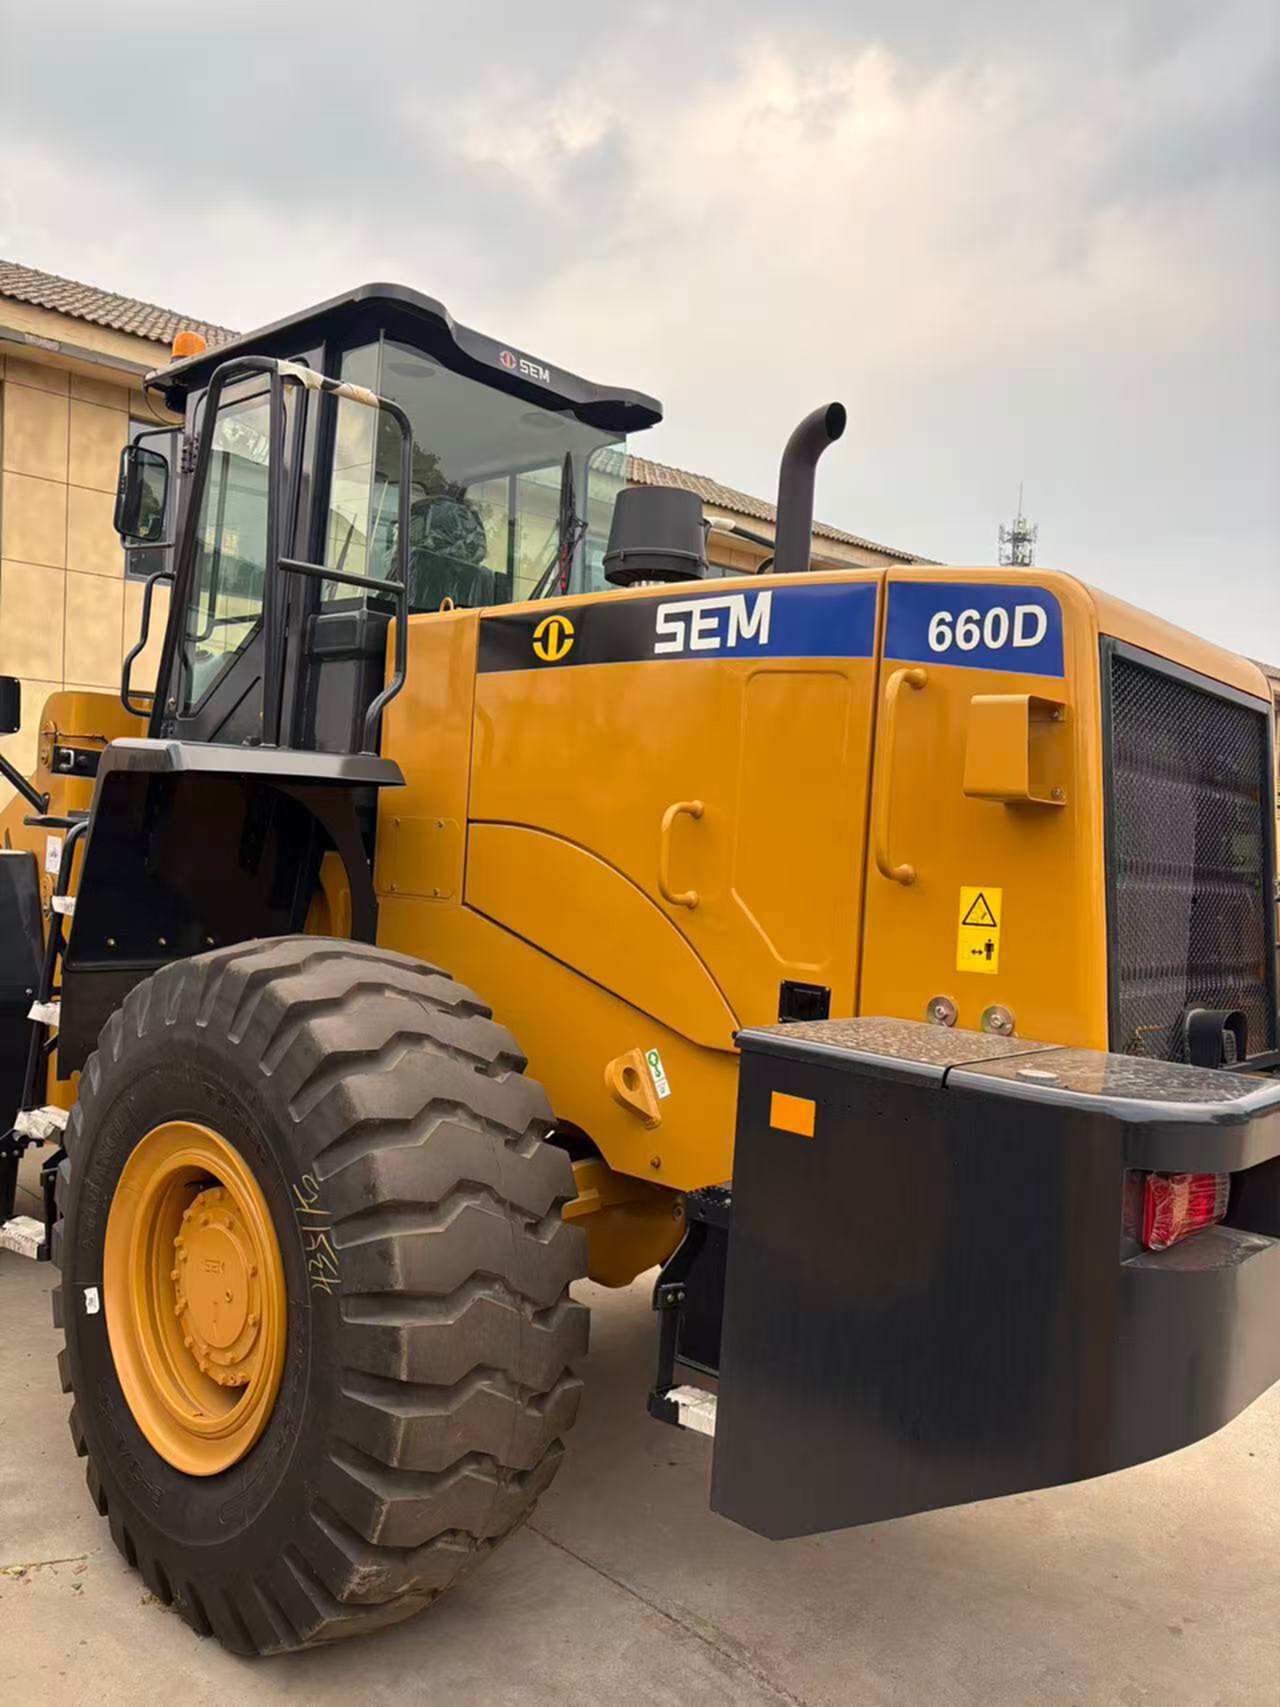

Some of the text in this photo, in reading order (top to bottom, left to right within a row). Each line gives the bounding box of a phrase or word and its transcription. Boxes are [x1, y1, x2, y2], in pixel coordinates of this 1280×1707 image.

[519, 359, 550, 383] SEM
[654, 590, 773, 654] SEM
[928, 604, 1048, 652] 660D
